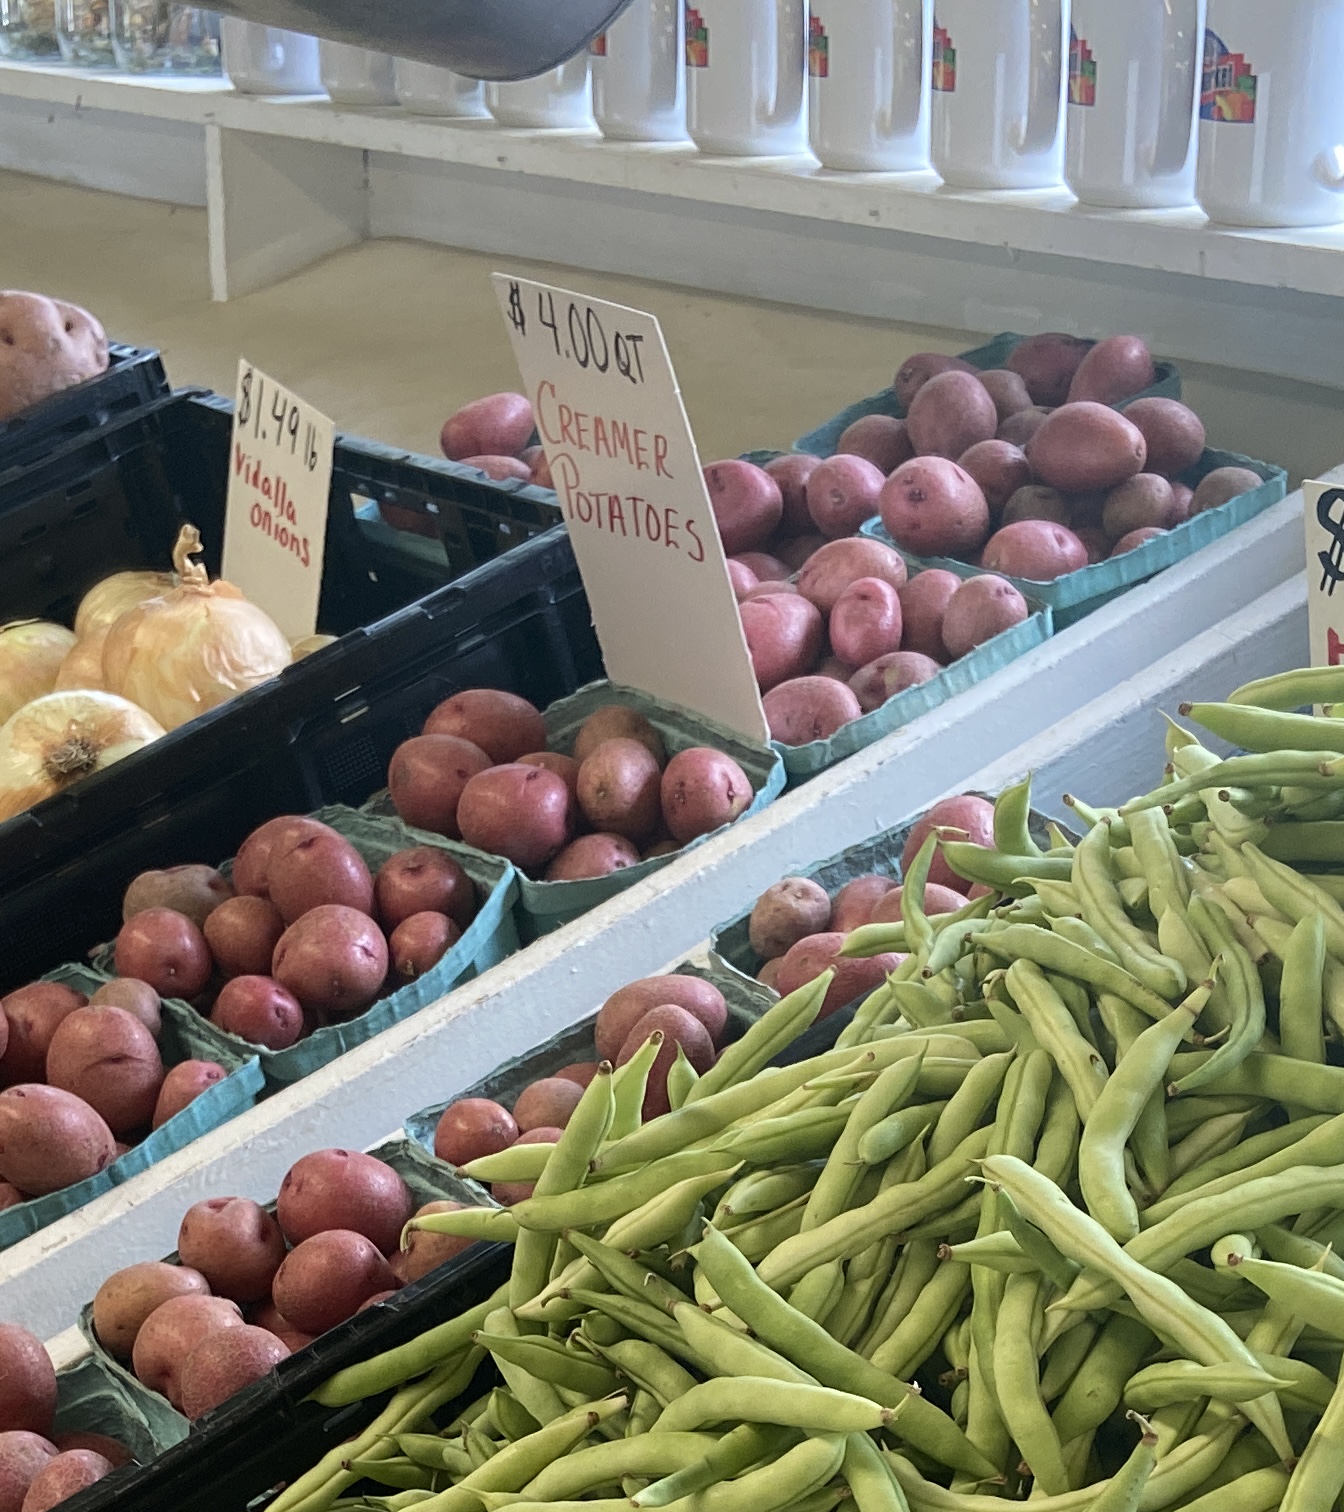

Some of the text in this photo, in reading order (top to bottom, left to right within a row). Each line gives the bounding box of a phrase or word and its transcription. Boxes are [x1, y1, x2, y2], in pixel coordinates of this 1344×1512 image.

[614, 331, 645, 385] QT
[238, 368, 300, 455] $1.49
[536, 380, 674, 480] CREAMER
[549, 452, 705, 563] POTATOES
